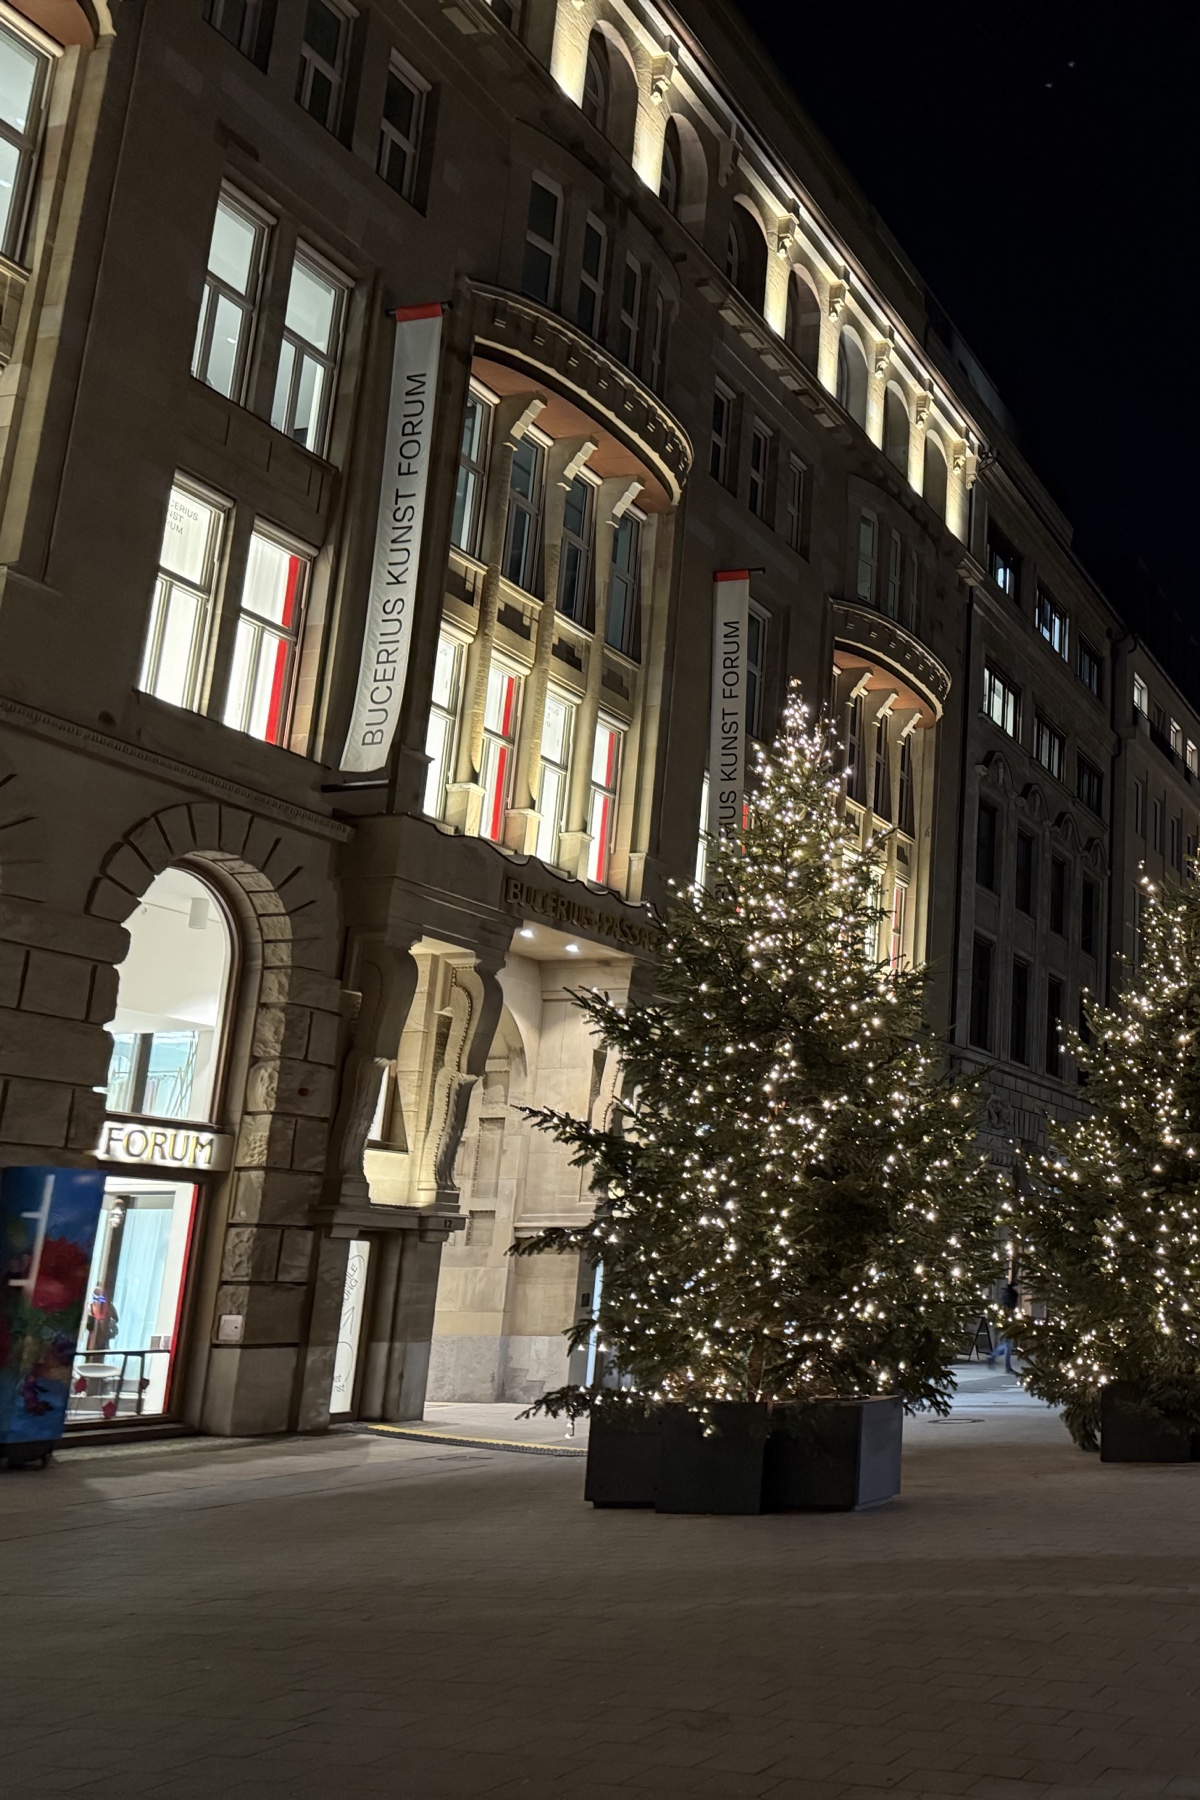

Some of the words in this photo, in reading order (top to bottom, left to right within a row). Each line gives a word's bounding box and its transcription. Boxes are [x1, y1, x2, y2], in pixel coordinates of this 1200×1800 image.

[398, 373, 427, 477] FORUM
[386, 488, 417, 585] KUNST
[361, 598, 405, 746] BUCERIUS
[722, 621, 740, 699] FORUM
[720, 708, 739, 782] KUNST
[103, 1127, 215, 1165] FORUM
